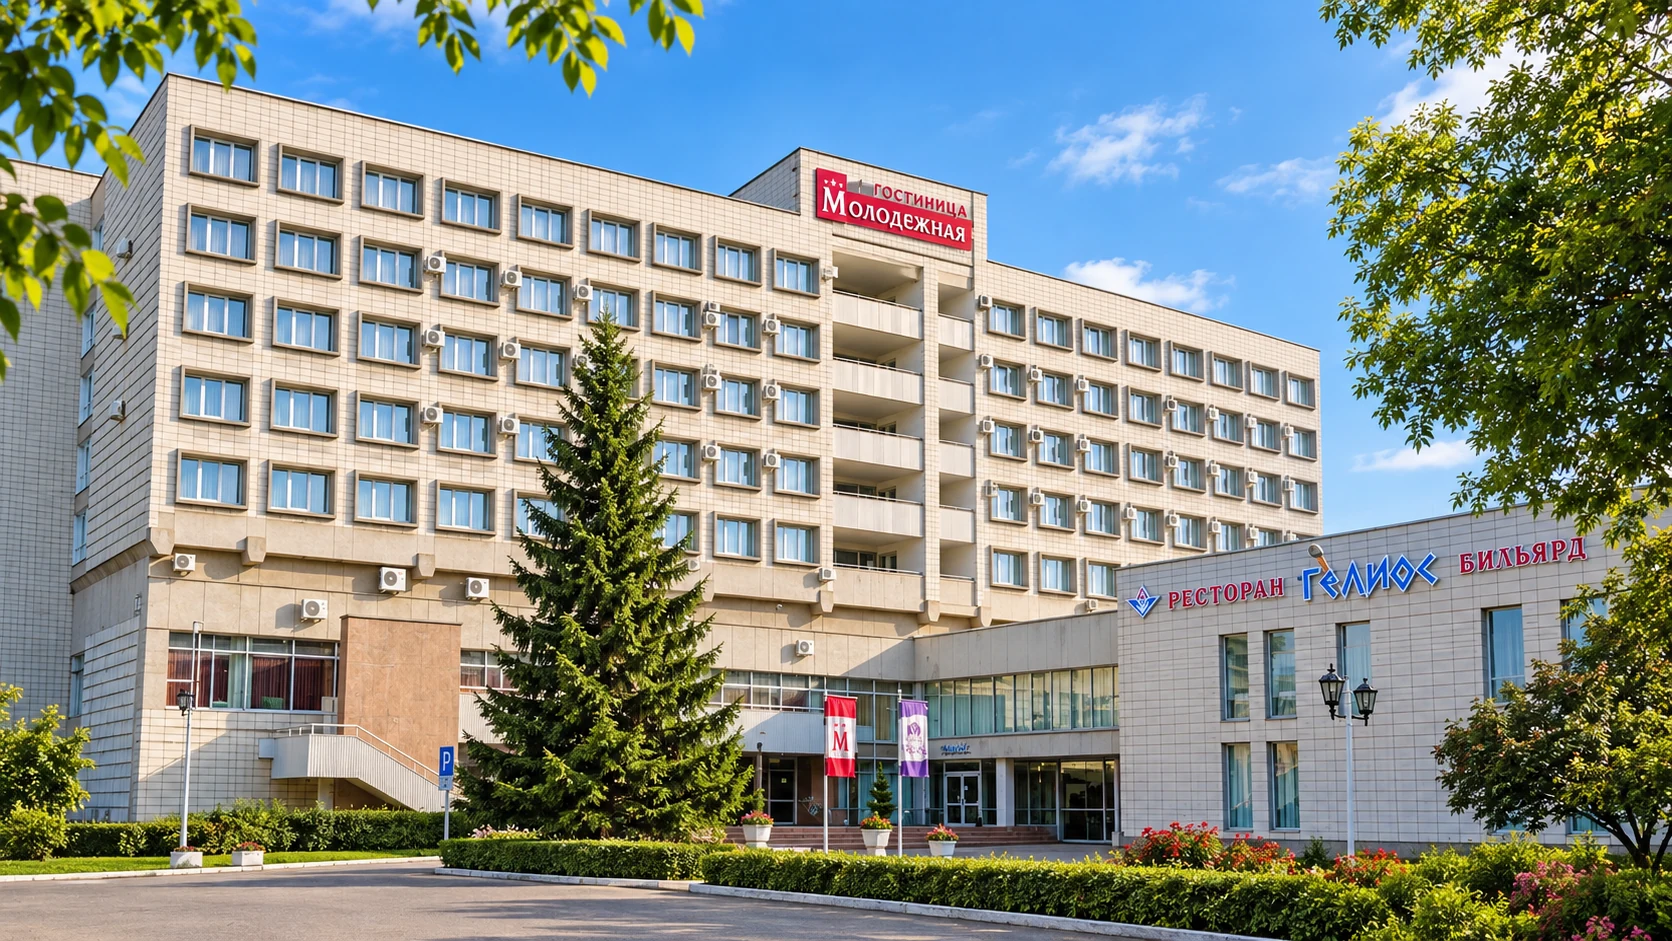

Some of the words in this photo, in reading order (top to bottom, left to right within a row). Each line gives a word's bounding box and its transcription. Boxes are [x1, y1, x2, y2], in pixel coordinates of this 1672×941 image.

[873, 183, 967, 219] ГОСТИНИЦА
[1168, 577, 1284, 611] РЕСТОРАН
[1459, 536, 1588, 575] БИЛЬЯРД
[442, 751, 451, 772] P
